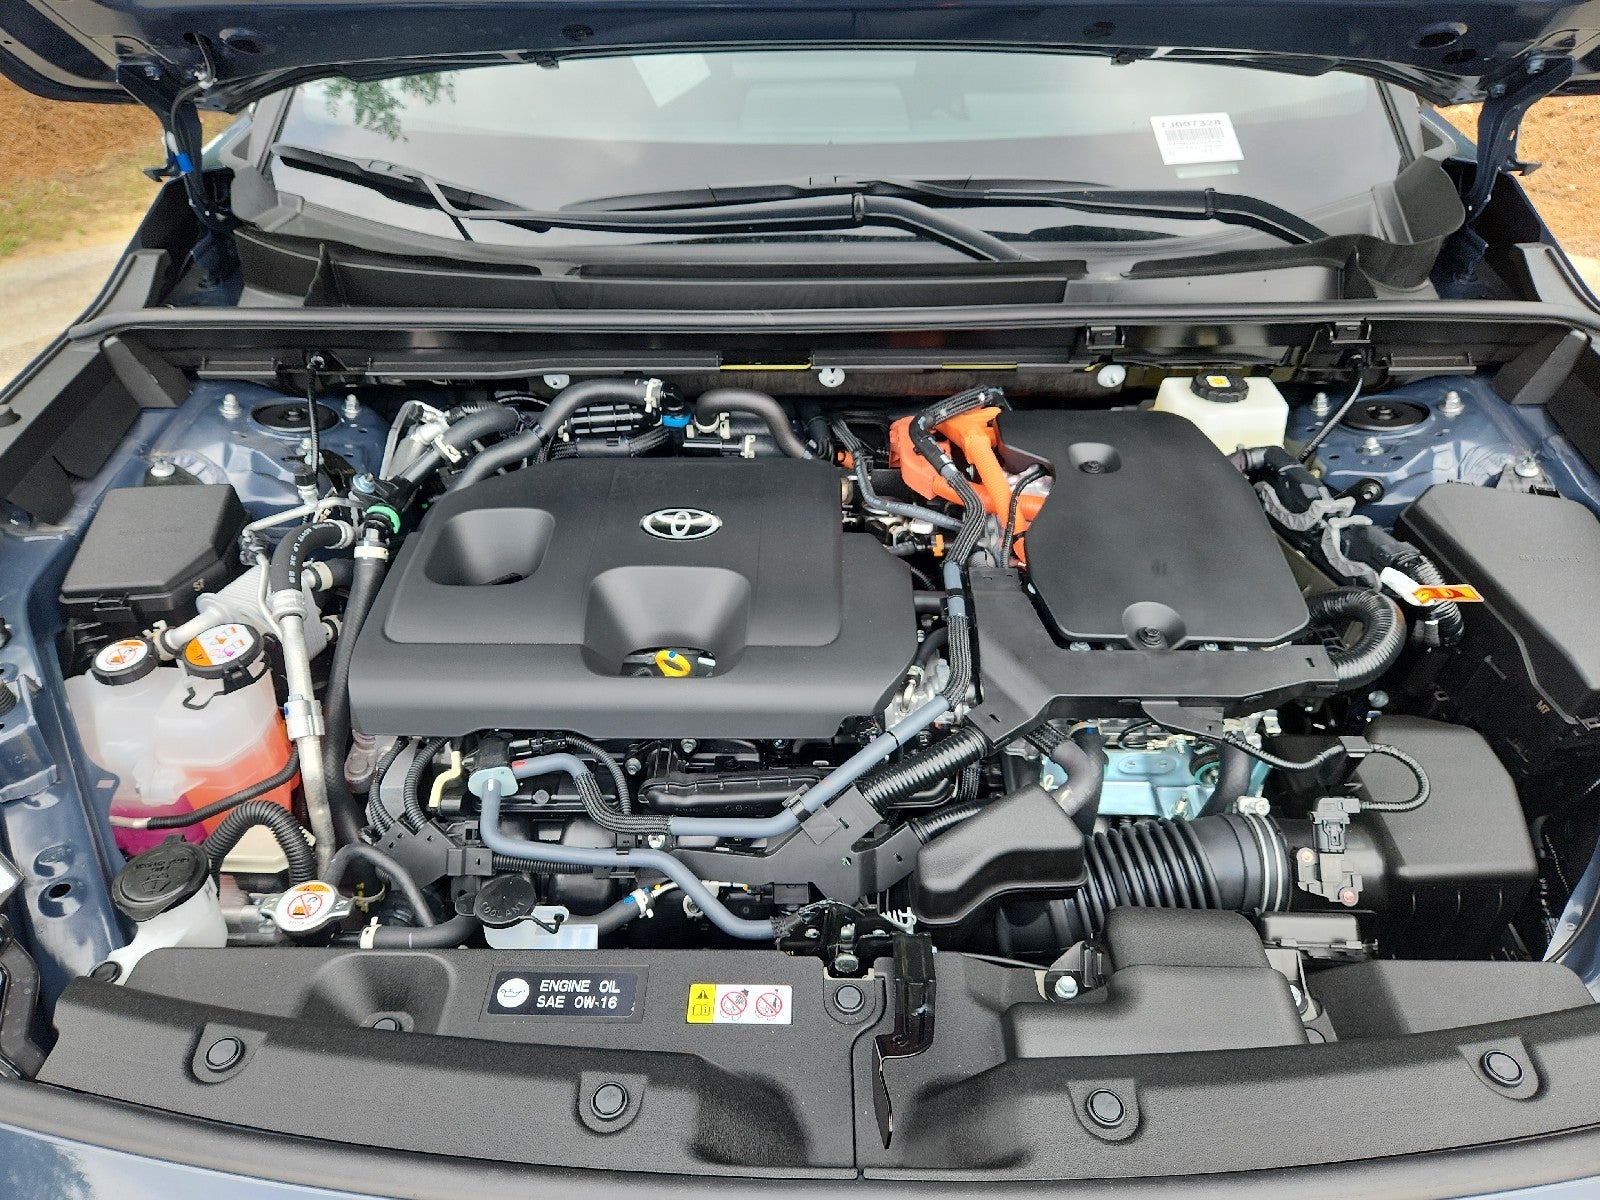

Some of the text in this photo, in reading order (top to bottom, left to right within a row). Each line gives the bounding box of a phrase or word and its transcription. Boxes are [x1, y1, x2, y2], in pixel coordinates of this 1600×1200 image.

[480, 901, 526, 918] COOLANT
[540, 979, 621, 993] ENGINE OIL
[536, 995, 618, 1009] SAE 0W-16
